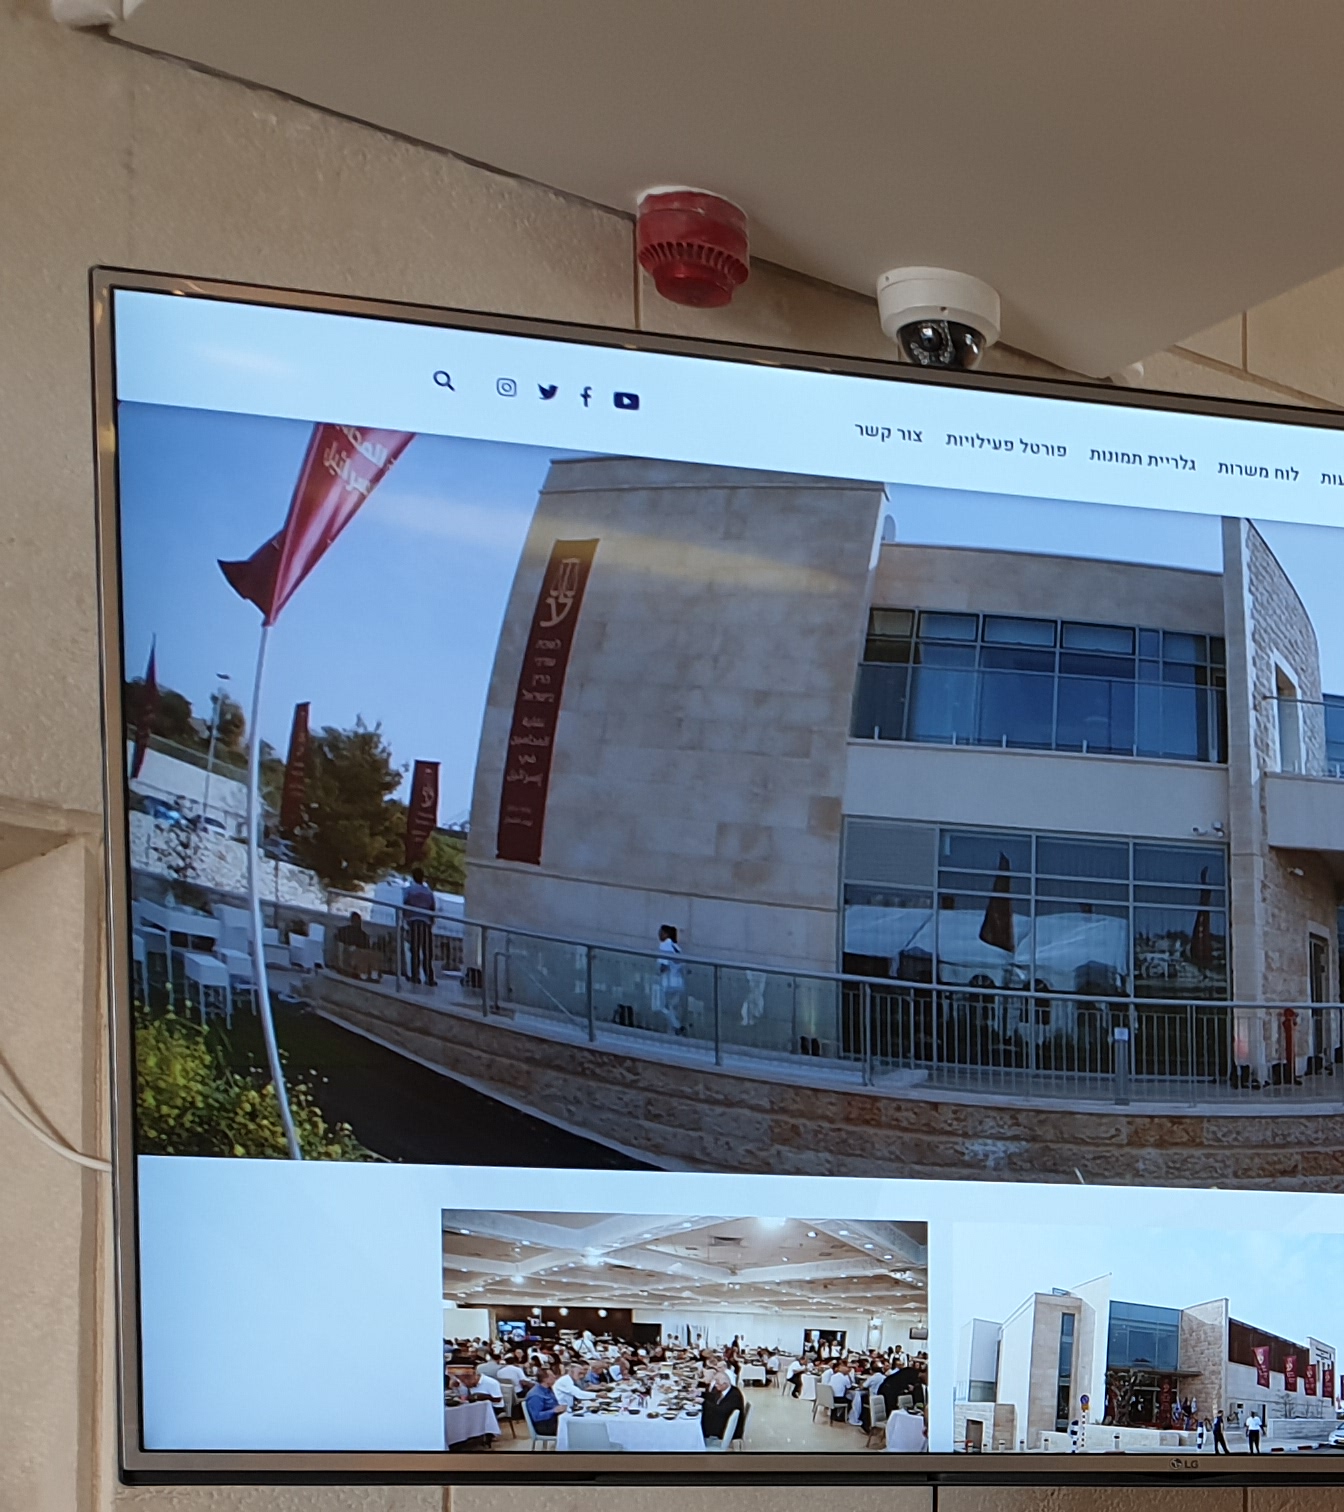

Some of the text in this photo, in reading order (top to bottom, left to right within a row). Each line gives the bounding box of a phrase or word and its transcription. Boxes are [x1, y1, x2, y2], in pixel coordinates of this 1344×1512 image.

[854, 423, 892, 442] קשר
[897, 427, 923, 443] צור
[946, 432, 1014, 451] פעילויות
[1020, 438, 1067, 457] פורטל
[1089, 446, 1143, 466] תמונות
[1147, 453, 1196, 472] גלריית
[1218, 461, 1269, 479] משרות
[1274, 466, 1300, 482] לוח
[1184, 1459, 1199, 1469] LG
